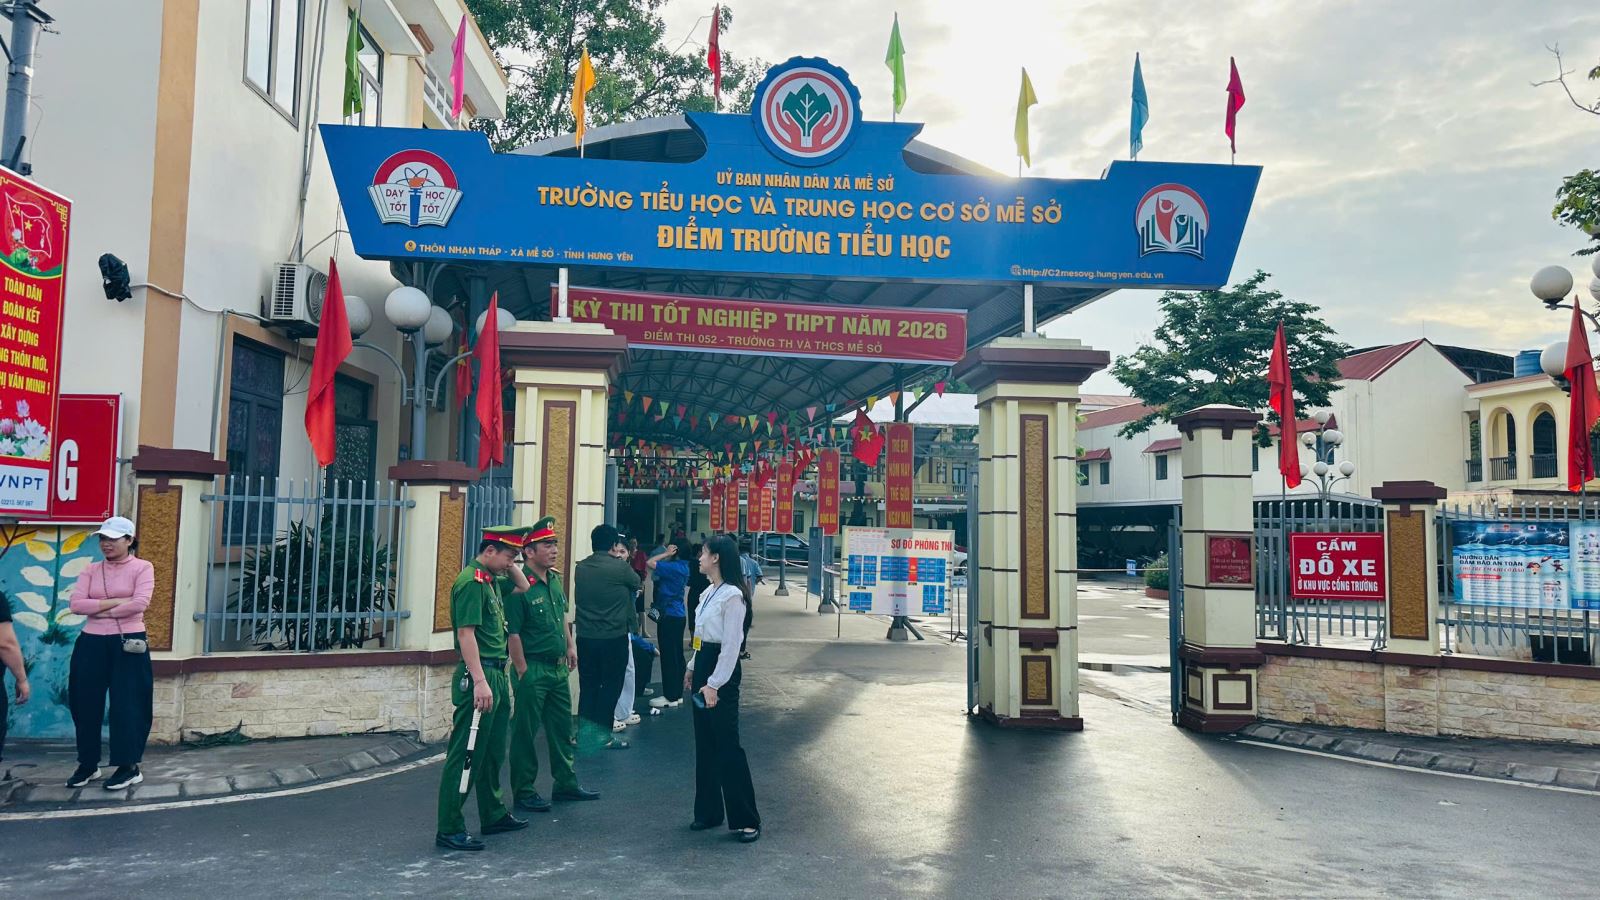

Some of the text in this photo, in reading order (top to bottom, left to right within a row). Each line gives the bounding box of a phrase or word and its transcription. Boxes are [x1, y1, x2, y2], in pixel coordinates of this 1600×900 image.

[736, 172, 761, 186] BAN
[764, 172, 800, 188] NHÂN
[804, 173, 829, 189] DÂN
[833, 174, 850, 190] XÃ
[877, 174, 894, 191] SỞ
[386, 188, 404, 200] DẠY
[425, 191, 444, 202] HỌC
[538, 180, 1062, 224] TRƯỜNG TIỂU HỌC VÀ TRUNG HỌC CƠ SỞ MỄ SỞ
[390, 201, 406, 212] TỐT
[422, 202, 440, 214] TỐT
[657, 216, 950, 262] ĐIỂM TRƯỜNG TIỂU HỌC
[419, 242, 446, 253] THÔN
[448, 246, 476, 256] NHẠN
[478, 244, 502, 256] THÁP
[564, 248, 584, 259] TỈNH
[588, 250, 613, 260] HƯNG
[616, 252, 634, 262] YÊN
[4, 276, 42, 302] TOÀN DÂN
[2, 300, 40, 324] ĐOÀN KẾT
[572, 297, 948, 340] KỲ THI TỐT NGHIỆP THPT NĂM 2026
[0, 322, 39, 347] XÂY DỰNG
[644, 328, 672, 342] ĐIỂM
[676, 332, 694, 342] THI
[698, 334, 717, 344] 052
[728, 334, 775, 348] TRƯỜNG
[778, 338, 793, 348] TH
[797, 338, 812, 350] VÀ
[816, 341, 844, 352] THCS
[10, 350, 30, 368] THÔN
[8, 371, 24, 390] VĂN
[26, 376, 46, 394] MINH
[891, 538, 900, 549] SƠ
[902, 537, 913, 550] ĐỒ
[914, 538, 939, 551] PHÒNG
[942, 541, 952, 551] THI
[1316, 538, 1356, 551] CẤM
[1299, 552, 1377, 576] ĐỖ XE
[1304, 580, 1316, 591] KHU
[1318, 580, 1331, 592] VỰC
[1332, 576, 1350, 592] CỔNG
[1351, 578, 1378, 592] TRƯỜNG
